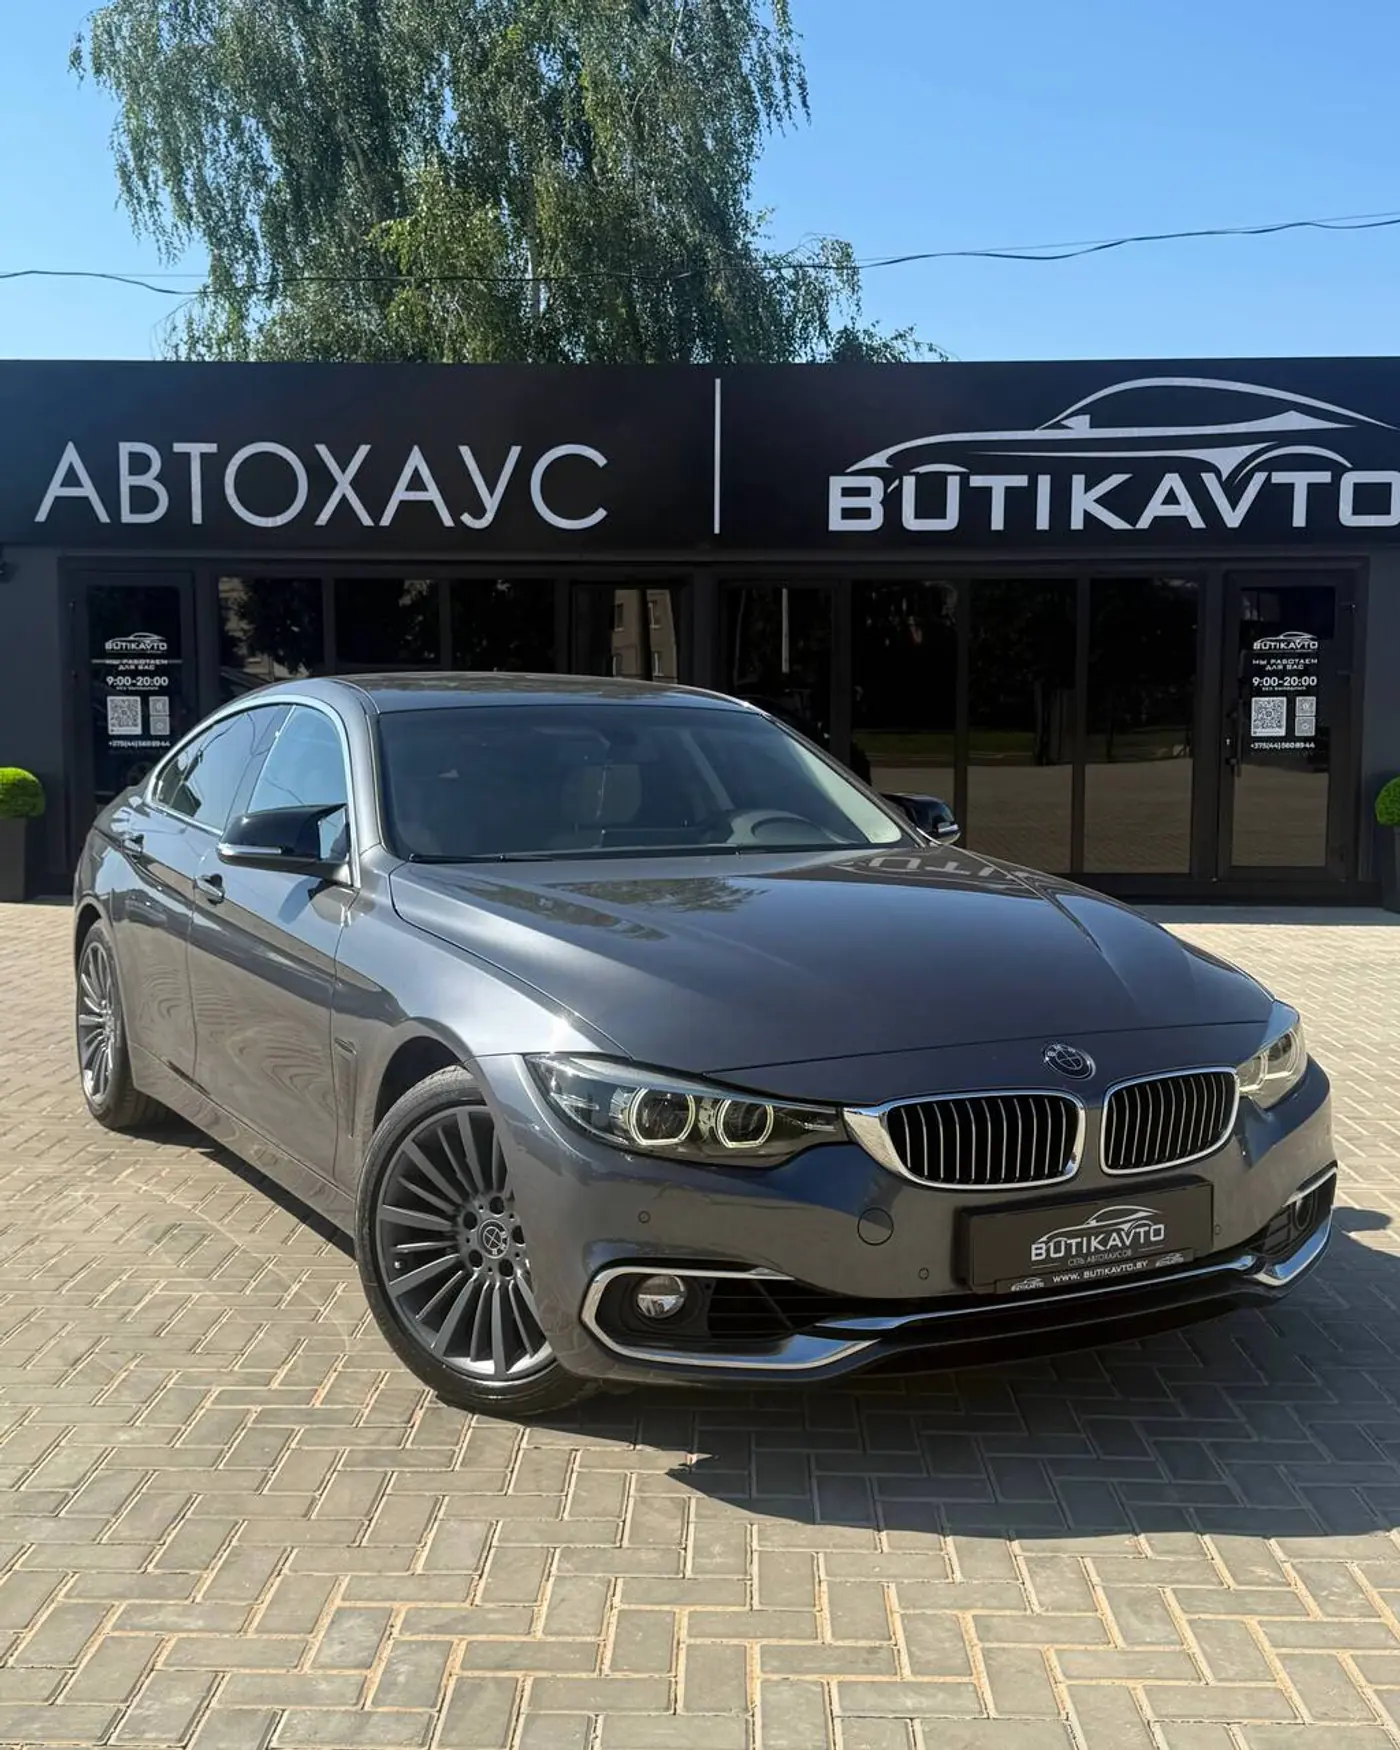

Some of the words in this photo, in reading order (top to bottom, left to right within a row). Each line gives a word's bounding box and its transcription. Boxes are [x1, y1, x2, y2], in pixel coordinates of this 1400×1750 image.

[34, 441, 608, 530] АВТОХАУС
[828, 470, 1400, 532] BUTIKAVTO
[105, 641, 168, 650] BUTIKAVTO
[1253, 641, 1318, 650] BUTIKAVTO
[106, 676, 169, 687] 9:00-20:00
[1252, 676, 1317, 687] 9:00-20:00
[1031, 1224, 1165, 1261] BUTIKAVTO
[1052, 1272, 1081, 1284] WWW.
[1084, 1260, 1149, 1279] BUTIKAVTO.BY
